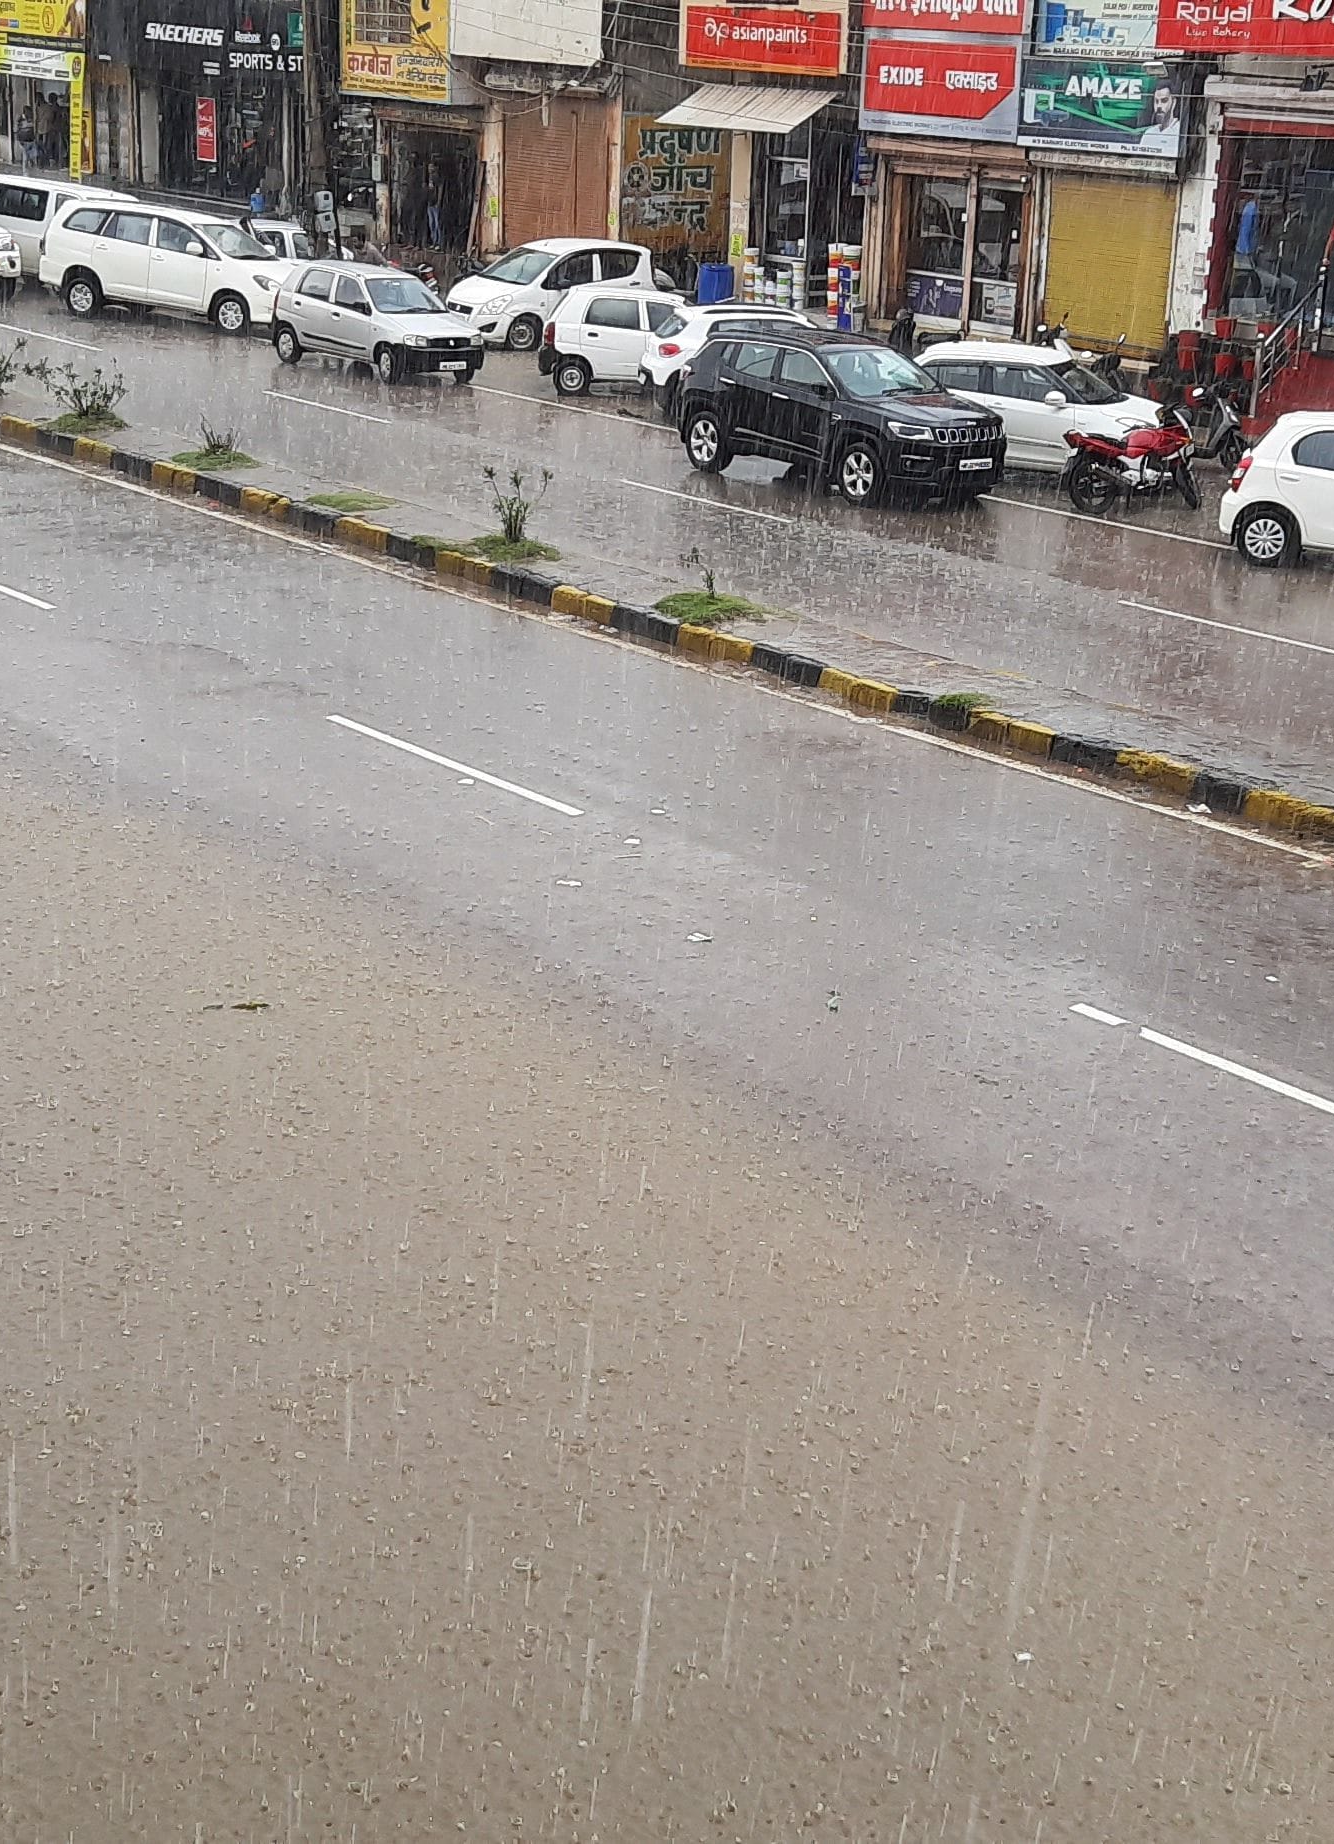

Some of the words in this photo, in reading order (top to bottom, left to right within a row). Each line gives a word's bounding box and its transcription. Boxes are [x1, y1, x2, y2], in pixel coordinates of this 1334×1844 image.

[1176, 1, 1252, 25] Royal
[144, 22, 224, 46] SKECHERS
[732, 20, 807, 50] asianpaints
[229, 53, 273, 71] SPORTS
[276, 54, 285, 71] &
[879, 65, 924, 86] EXIDE
[1065, 75, 1143, 100] AMAZE
